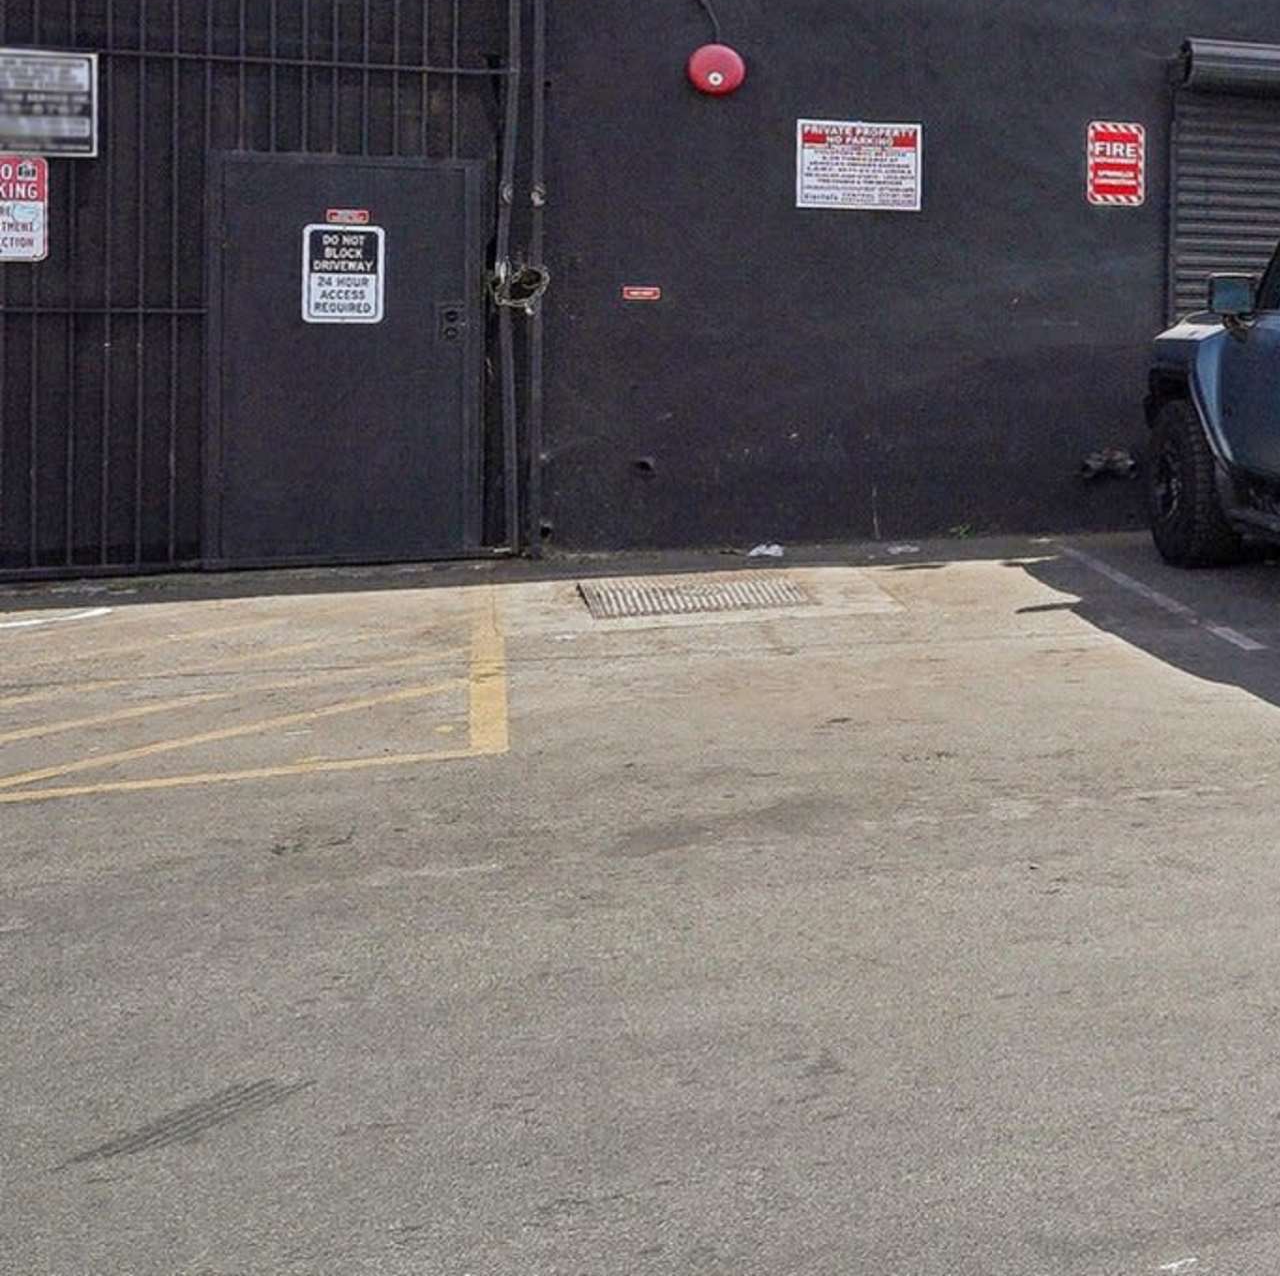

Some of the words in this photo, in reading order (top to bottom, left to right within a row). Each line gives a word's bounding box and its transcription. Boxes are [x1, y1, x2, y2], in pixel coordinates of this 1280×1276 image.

[804, 125, 853, 135] PRIVATE
[856, 126, 915, 137] PROPERTY
[826, 135, 841, 145] NO
[845, 136, 894, 147] PARKING
[1095, 141, 1137, 158] FIRE
[0, 164, 12, 181] O
[0, 183, 38, 201] KING
[2, 221, 33, 233] TMENT
[1, 236, 34, 249] CTION
[322, 234, 339, 245] DO
[342, 235, 365, 246] NOT
[324, 247, 363, 259] BLOCK
[313, 259, 374, 271] DRIVEWAY
[317, 276, 332, 286] 24
[336, 277, 369, 287] HOUR
[320, 289, 366, 300] ACCESS
[314, 302, 372, 313] REQUIRED
